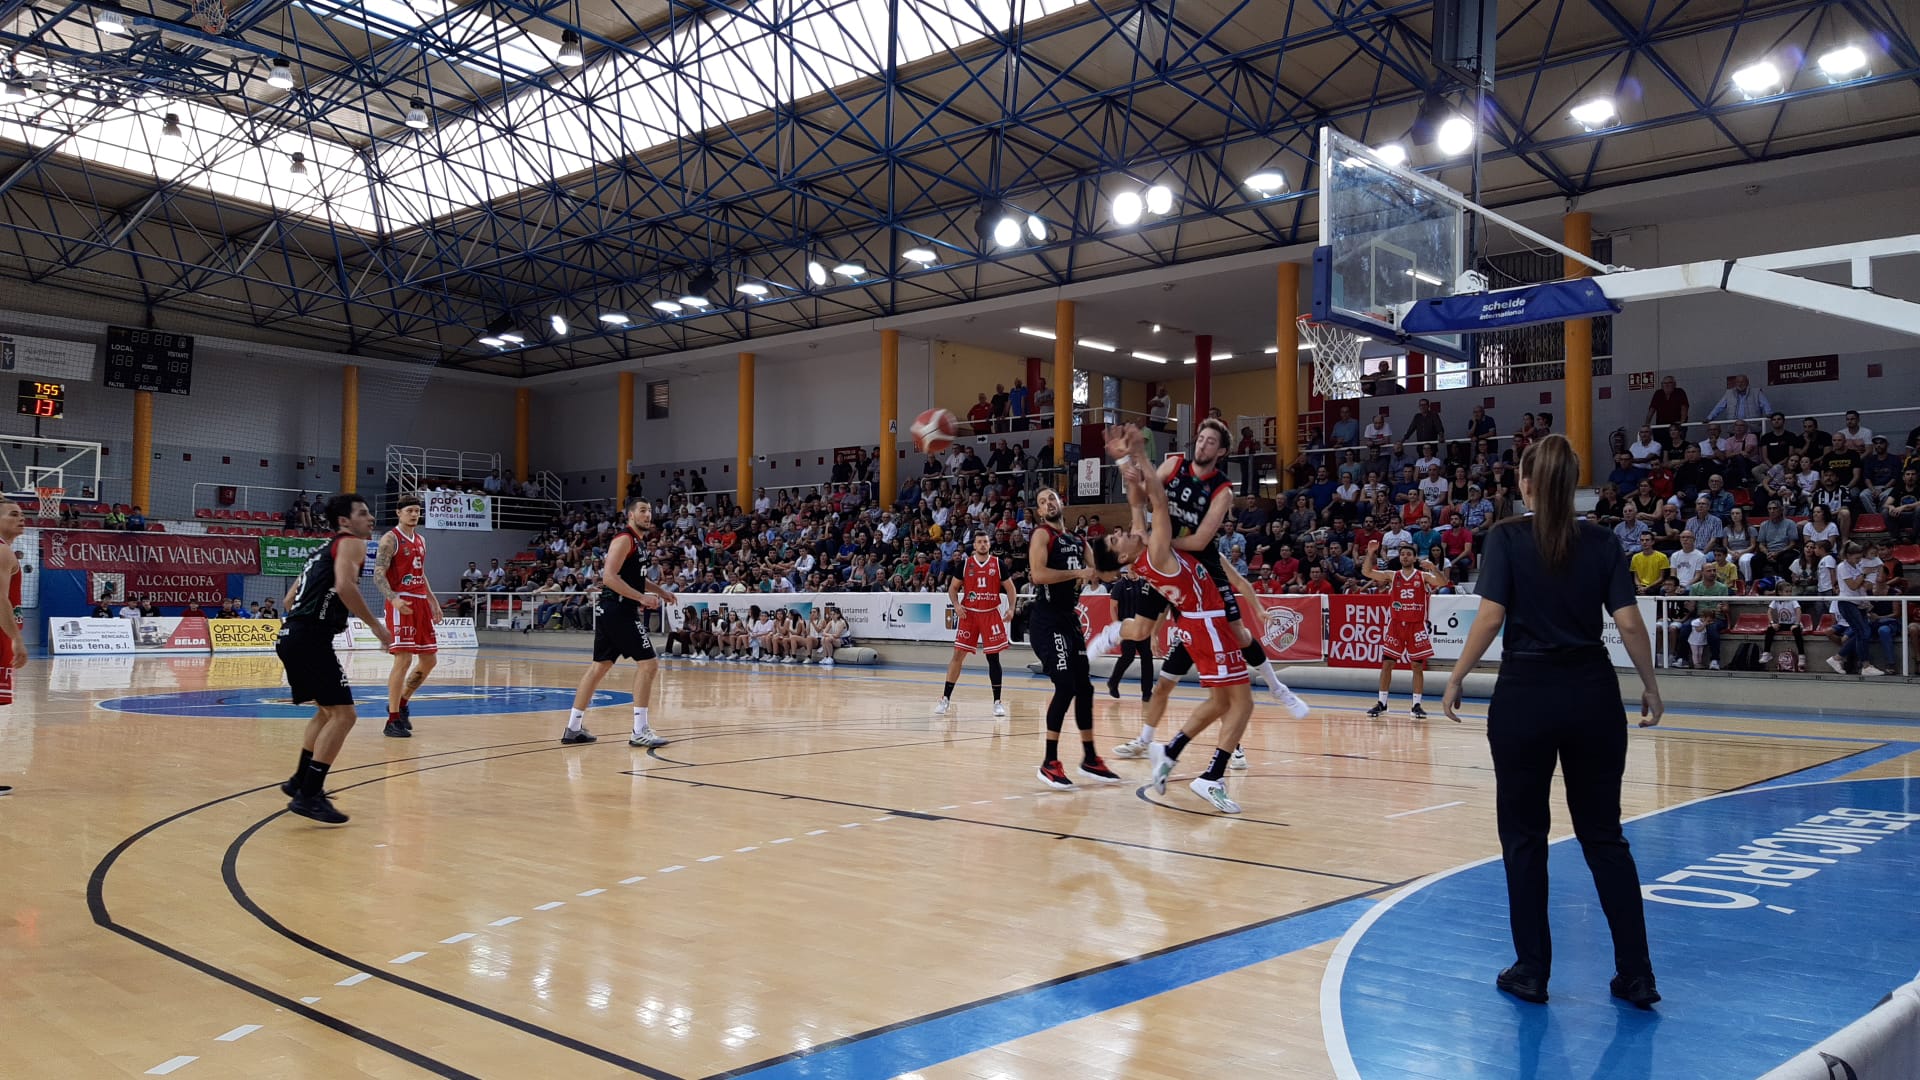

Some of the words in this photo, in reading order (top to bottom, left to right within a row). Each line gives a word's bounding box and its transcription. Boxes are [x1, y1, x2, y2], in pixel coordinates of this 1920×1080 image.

[1479, 307, 1525, 321] international
[111, 343, 134, 352] LOCAL
[1815, 360, 1827, 368] LES
[35, 399, 54, 416] 13
[889, 420, 897, 431] A
[1180, 486, 1192, 502] 8
[430, 497, 463, 506] padel
[69, 542, 164, 564] GENERALITAT
[167, 545, 257, 565] VALENCIANA
[136, 574, 215, 587] ALCACHOFA
[977, 577, 987, 588] 11
[149, 589, 222, 603] BENICARLÓ
[1400, 589, 1415, 599] 25
[213, 624, 259, 634] ÓPTICA
[1414, 630, 1427, 642] 25
[59, 642, 84, 650] elias
[87, 642, 114, 651] tena,
[114, 642, 130, 650] s.l.
[174, 638, 206, 646] BELDA
[1639, 807, 1920, 915] BENICARLÓ
